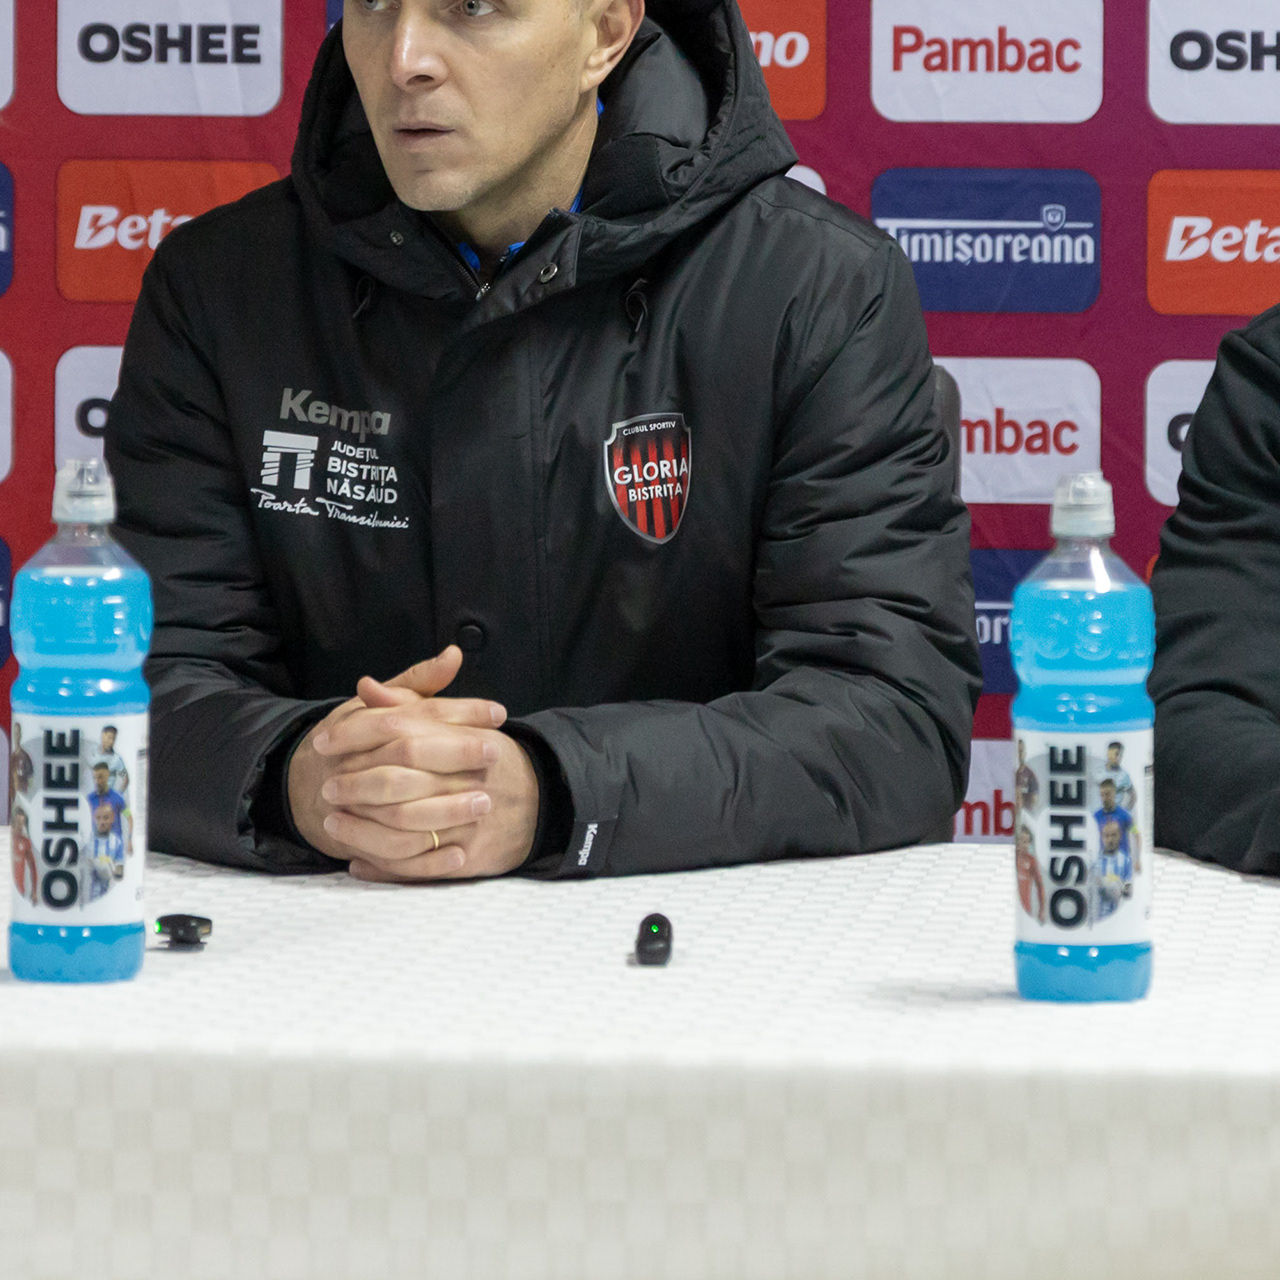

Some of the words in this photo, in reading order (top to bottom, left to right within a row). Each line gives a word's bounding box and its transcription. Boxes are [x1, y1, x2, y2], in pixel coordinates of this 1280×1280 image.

[78, 22, 262, 65] OSHEE
[892, 25, 1081, 74] Pambac
[279, 387, 391, 444] Kempa
[622, 424, 649, 437] CLUBUL
[648, 420, 677, 432] SPORTIV
[959, 406, 1080, 457] mbac
[326, 456, 399, 487] BISTRIȚA
[326, 478, 399, 505] NĂSĂUD
[613, 457, 689, 486] GLORIA
[627, 482, 684, 503] BISTRIȚA
[41, 727, 81, 911] OSHEE
[1049, 745, 1087, 931] OSHEE
[578, 823, 599, 866] Kempa
